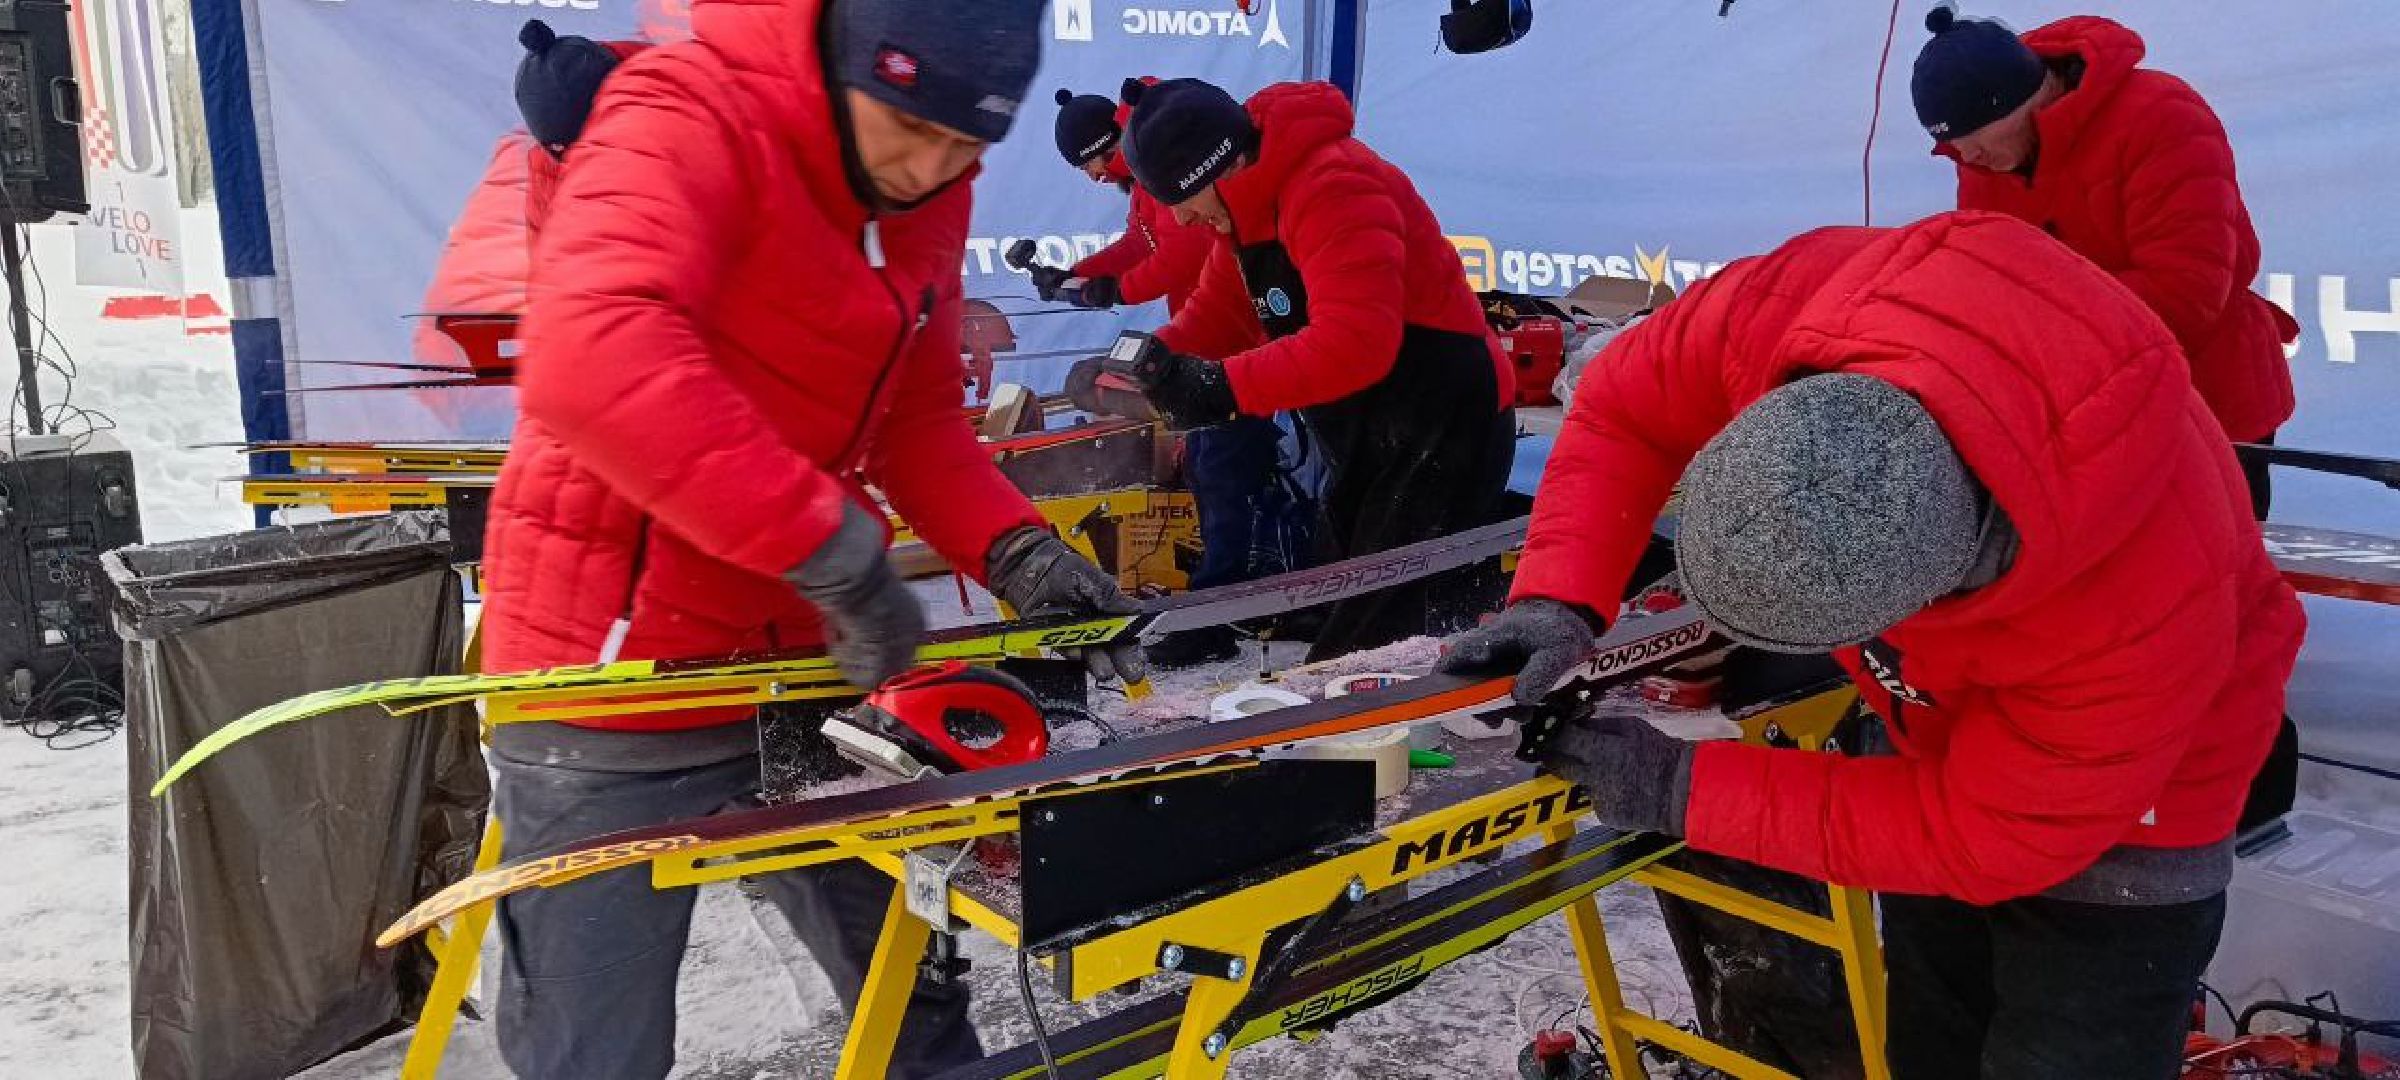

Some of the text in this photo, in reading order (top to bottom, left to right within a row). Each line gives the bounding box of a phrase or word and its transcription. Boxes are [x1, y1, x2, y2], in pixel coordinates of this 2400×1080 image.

[112, 231, 171, 260] LOVE
[1130, 506, 1193, 520] UTER
[1590, 619, 1705, 676] ROSSIGNOL
[1391, 784, 1592, 876] MASTE
[1280, 955, 1424, 1032] FISCHER
